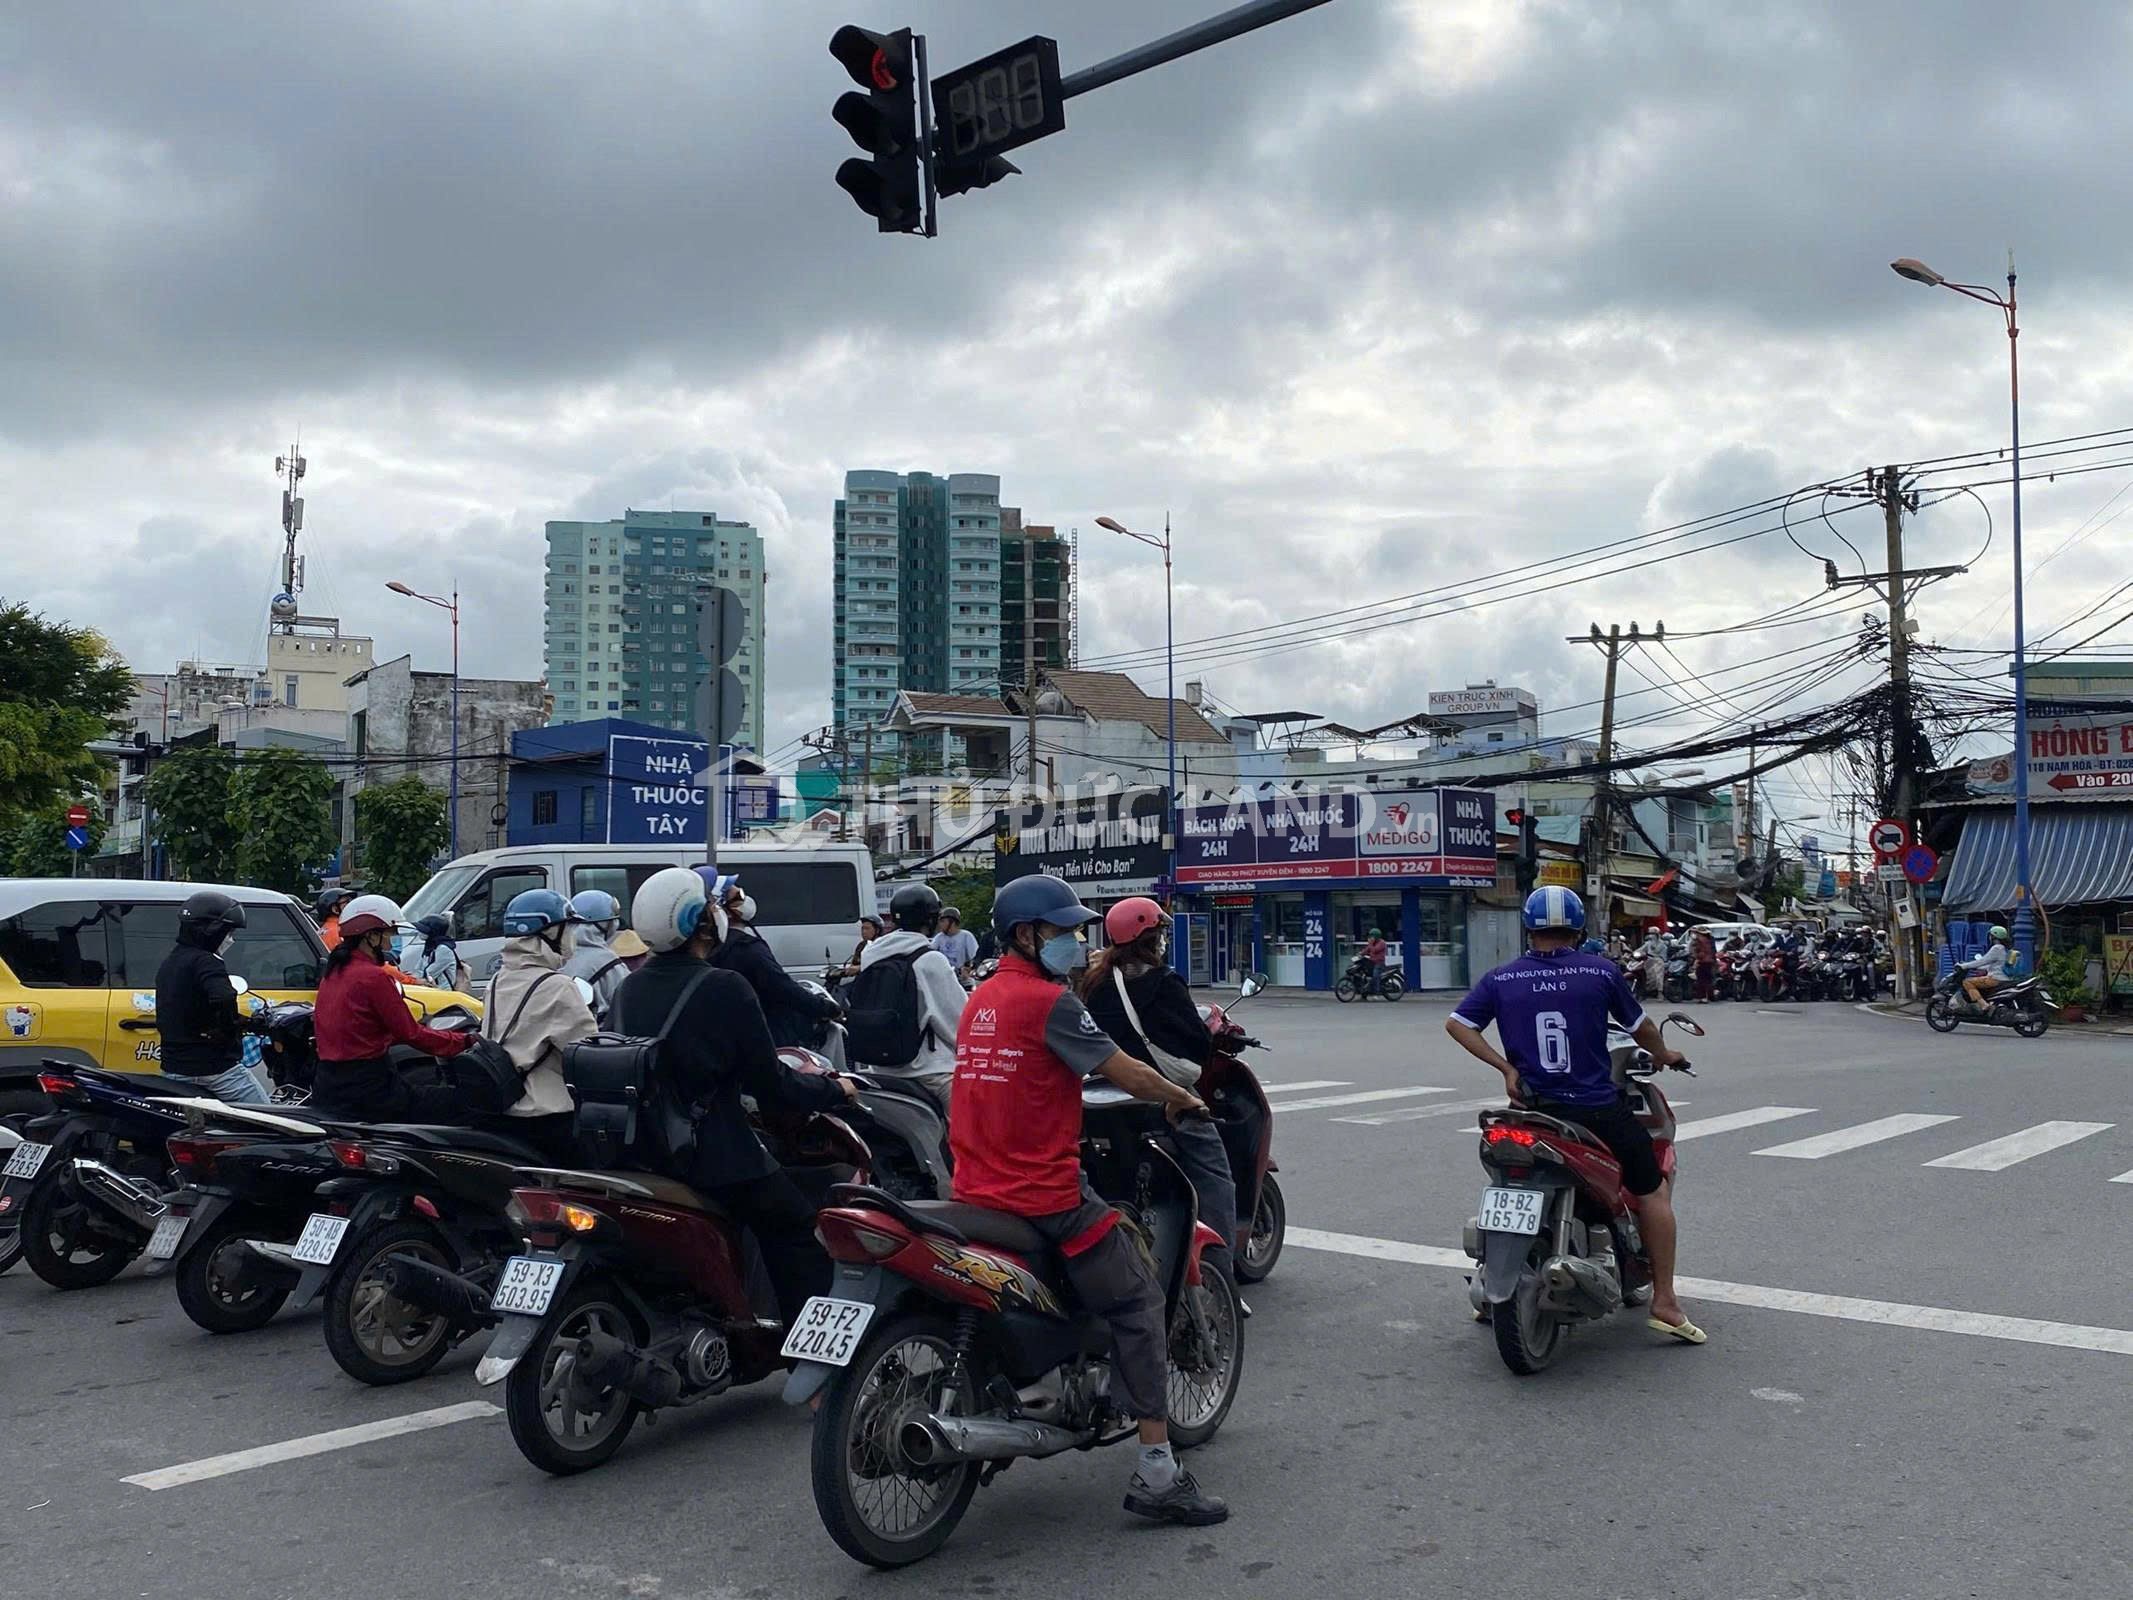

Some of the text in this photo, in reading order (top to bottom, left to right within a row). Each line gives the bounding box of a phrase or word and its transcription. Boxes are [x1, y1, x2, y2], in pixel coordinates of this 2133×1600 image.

[1489, 690, 1514, 700] XINH
[1447, 702, 1500, 713] GROUP.VN
[645, 752, 693, 775] NHÀ
[2027, 762, 2044, 772] 118
[2047, 761, 2070, 772] NAM
[2076, 772, 2133, 787] Vào 20
[632, 779, 705, 805] THUỐC
[1266, 803, 1345, 829] NHÀ THUỐC
[1456, 798, 1484, 820] NHÀ
[646, 813, 688, 835] TÂY
[1184, 813, 1246, 834] BÁCH HÓA
[1020, 828, 1045, 856] MUA
[1289, 834, 1319, 853] 24H
[1449, 822, 1491, 847] THUỐC
[1201, 840, 1228, 857] 24H
[1094, 860, 1112, 875] Cho
[1368, 860, 1433, 873] 1800 2247
[1306, 919, 1323, 934] 24
[1306, 943, 1323, 958] 24
[1559, 981, 1567, 991] 6
[1535, 1011, 1571, 1074] 6
[1493, 1191, 1534, 1212] 18-B2
[1484, 1209, 1537, 1231] 165.78
[511, 1261, 555, 1287] 59-X3
[496, 1285, 551, 1311] 503.95
[807, 1302, 860, 1331] 59-F2
[790, 1328, 853, 1359] 420.45
